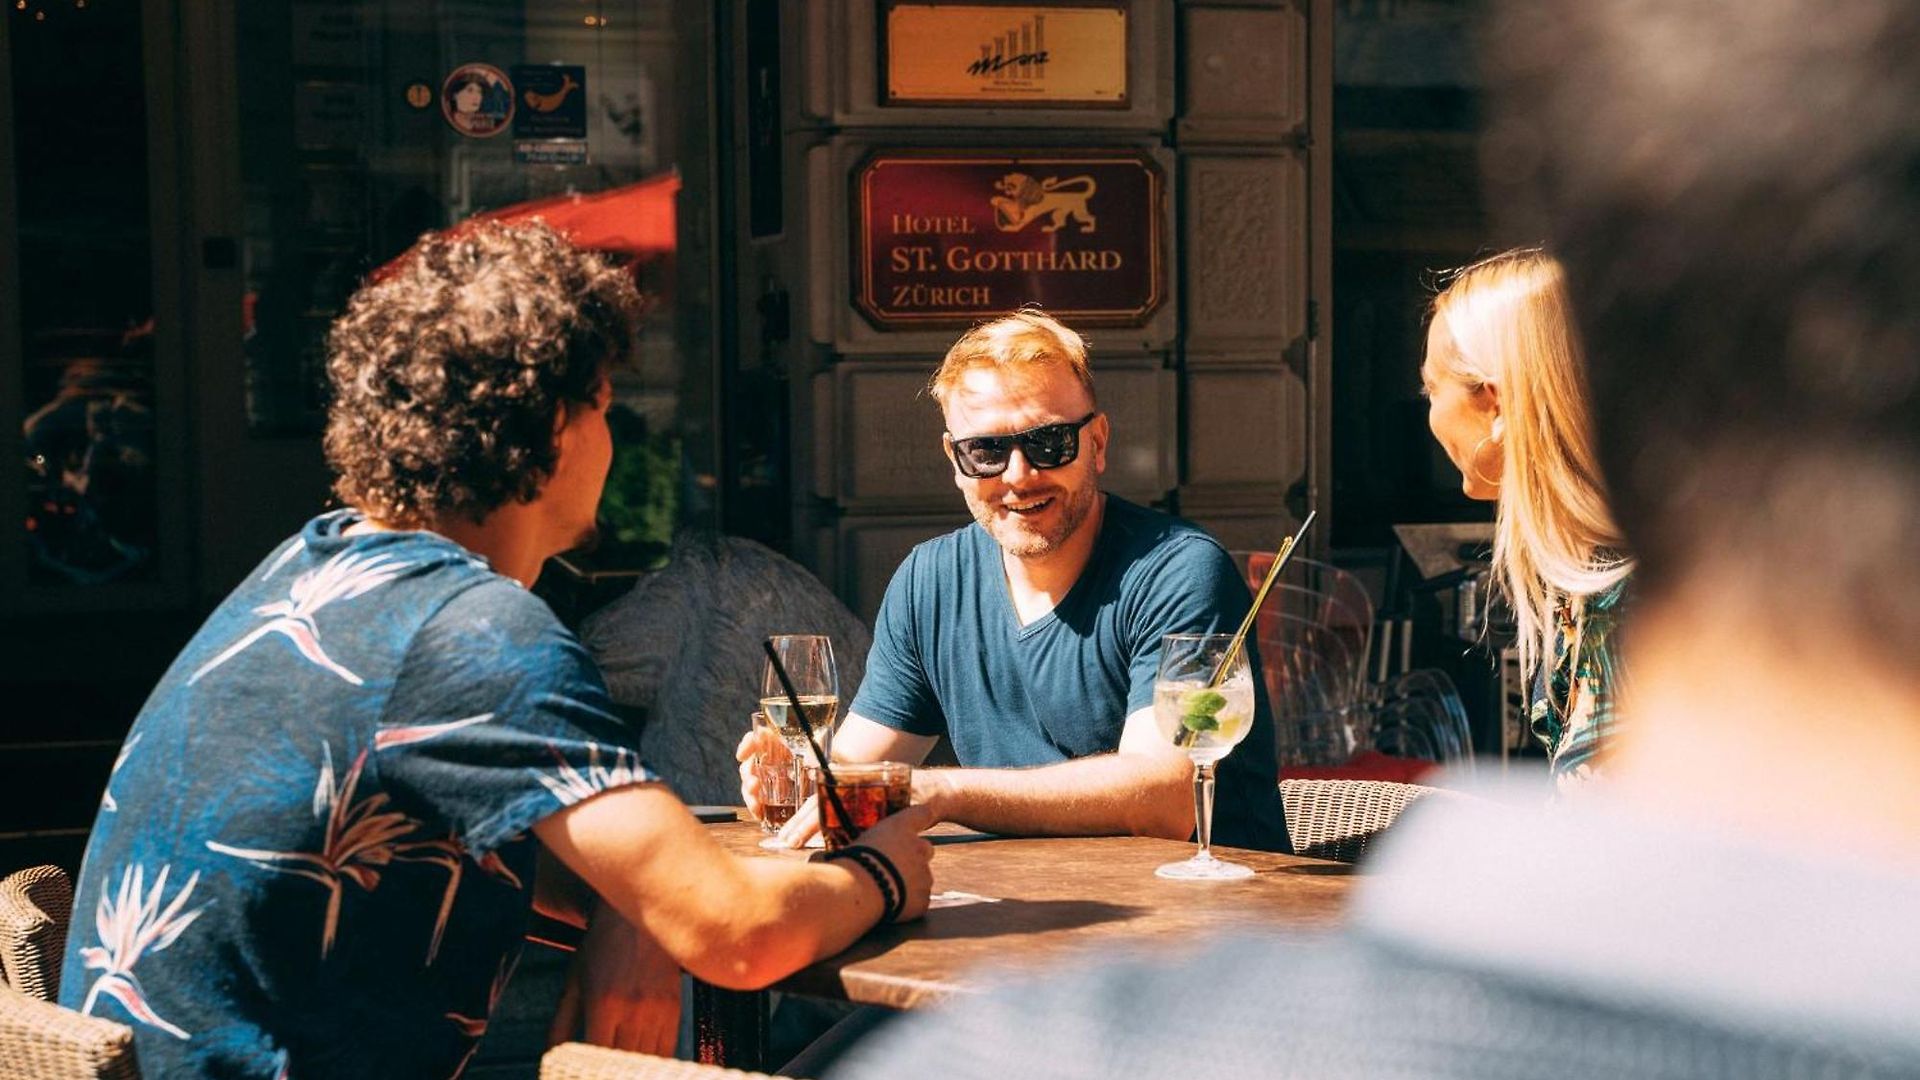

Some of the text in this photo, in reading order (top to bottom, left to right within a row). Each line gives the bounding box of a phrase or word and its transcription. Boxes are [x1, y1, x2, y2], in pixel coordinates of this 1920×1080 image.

[892, 214, 976, 235] HOTEL
[891, 246, 1122, 272] ST. GOTTHARD
[892, 283, 990, 307] ZÜRICH
